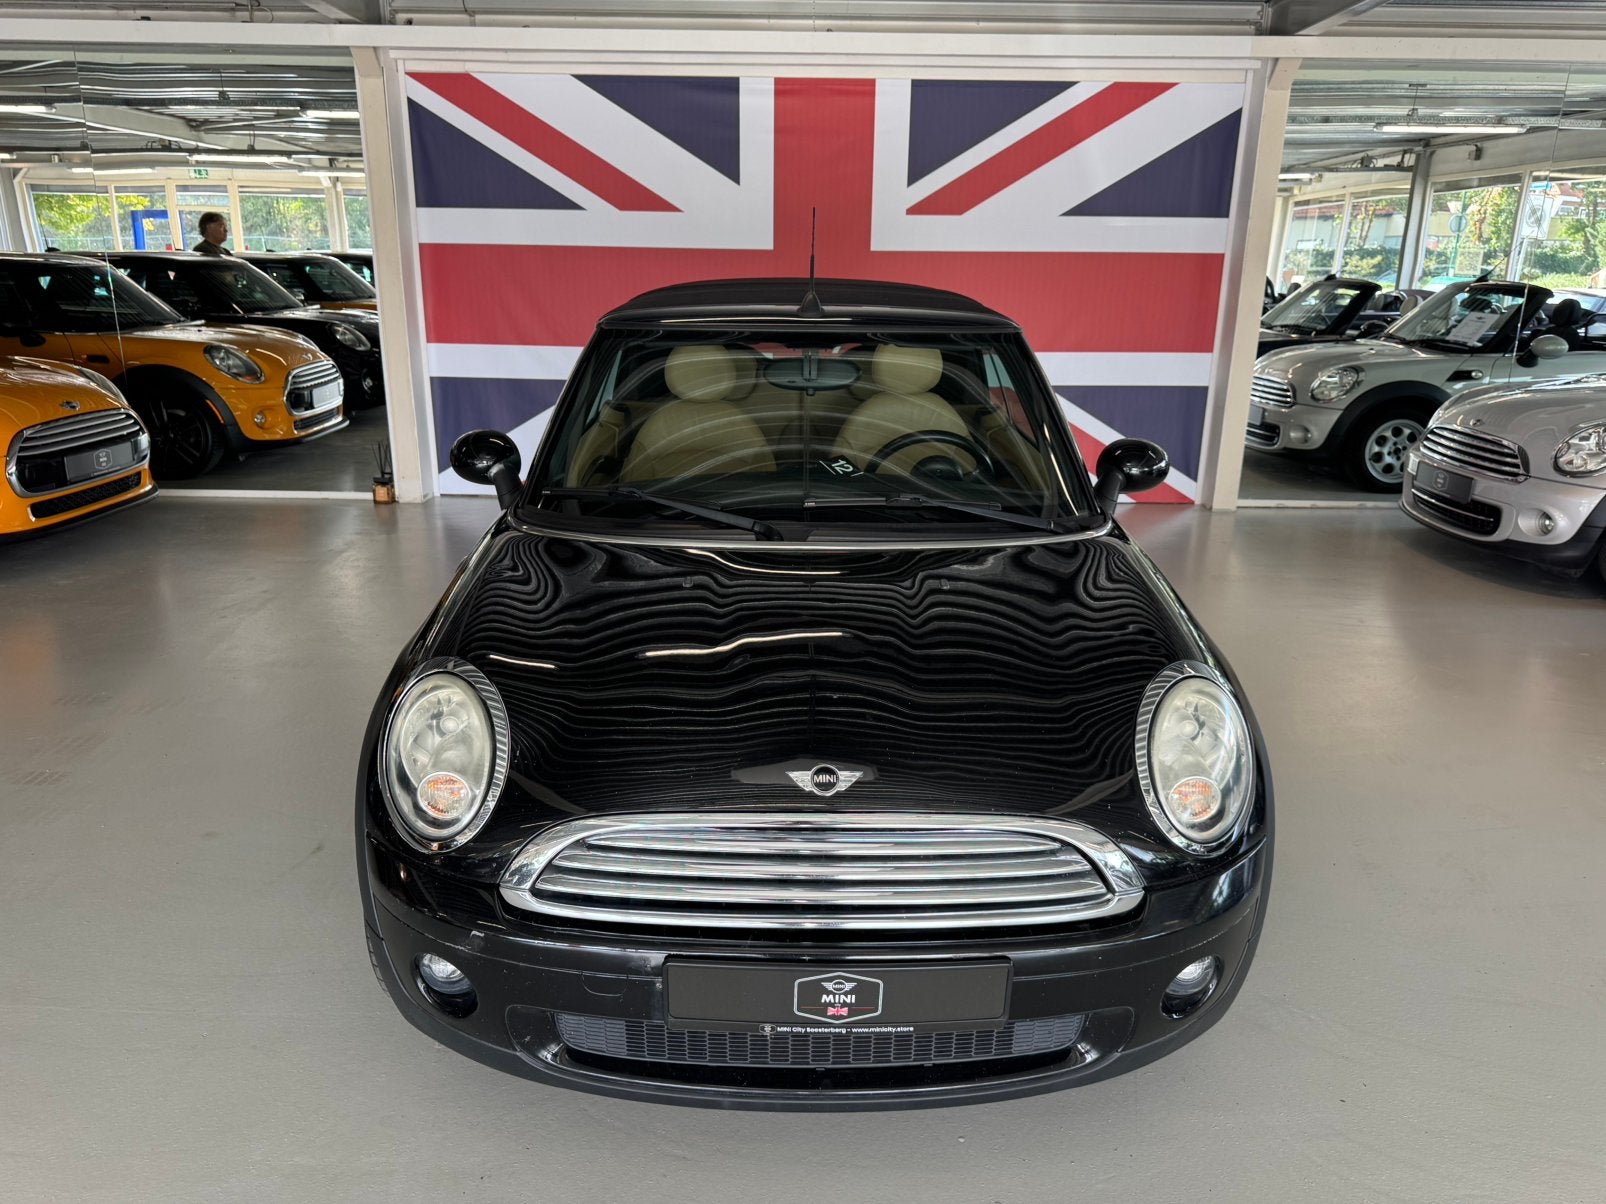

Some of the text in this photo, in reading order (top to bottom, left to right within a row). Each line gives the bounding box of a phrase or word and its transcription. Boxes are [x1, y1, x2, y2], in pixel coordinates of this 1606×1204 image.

[832, 459, 853, 475] 12
[813, 774, 837, 783] MINI
[821, 994, 856, 1003] MINI
[792, 1026, 806, 1034] City
